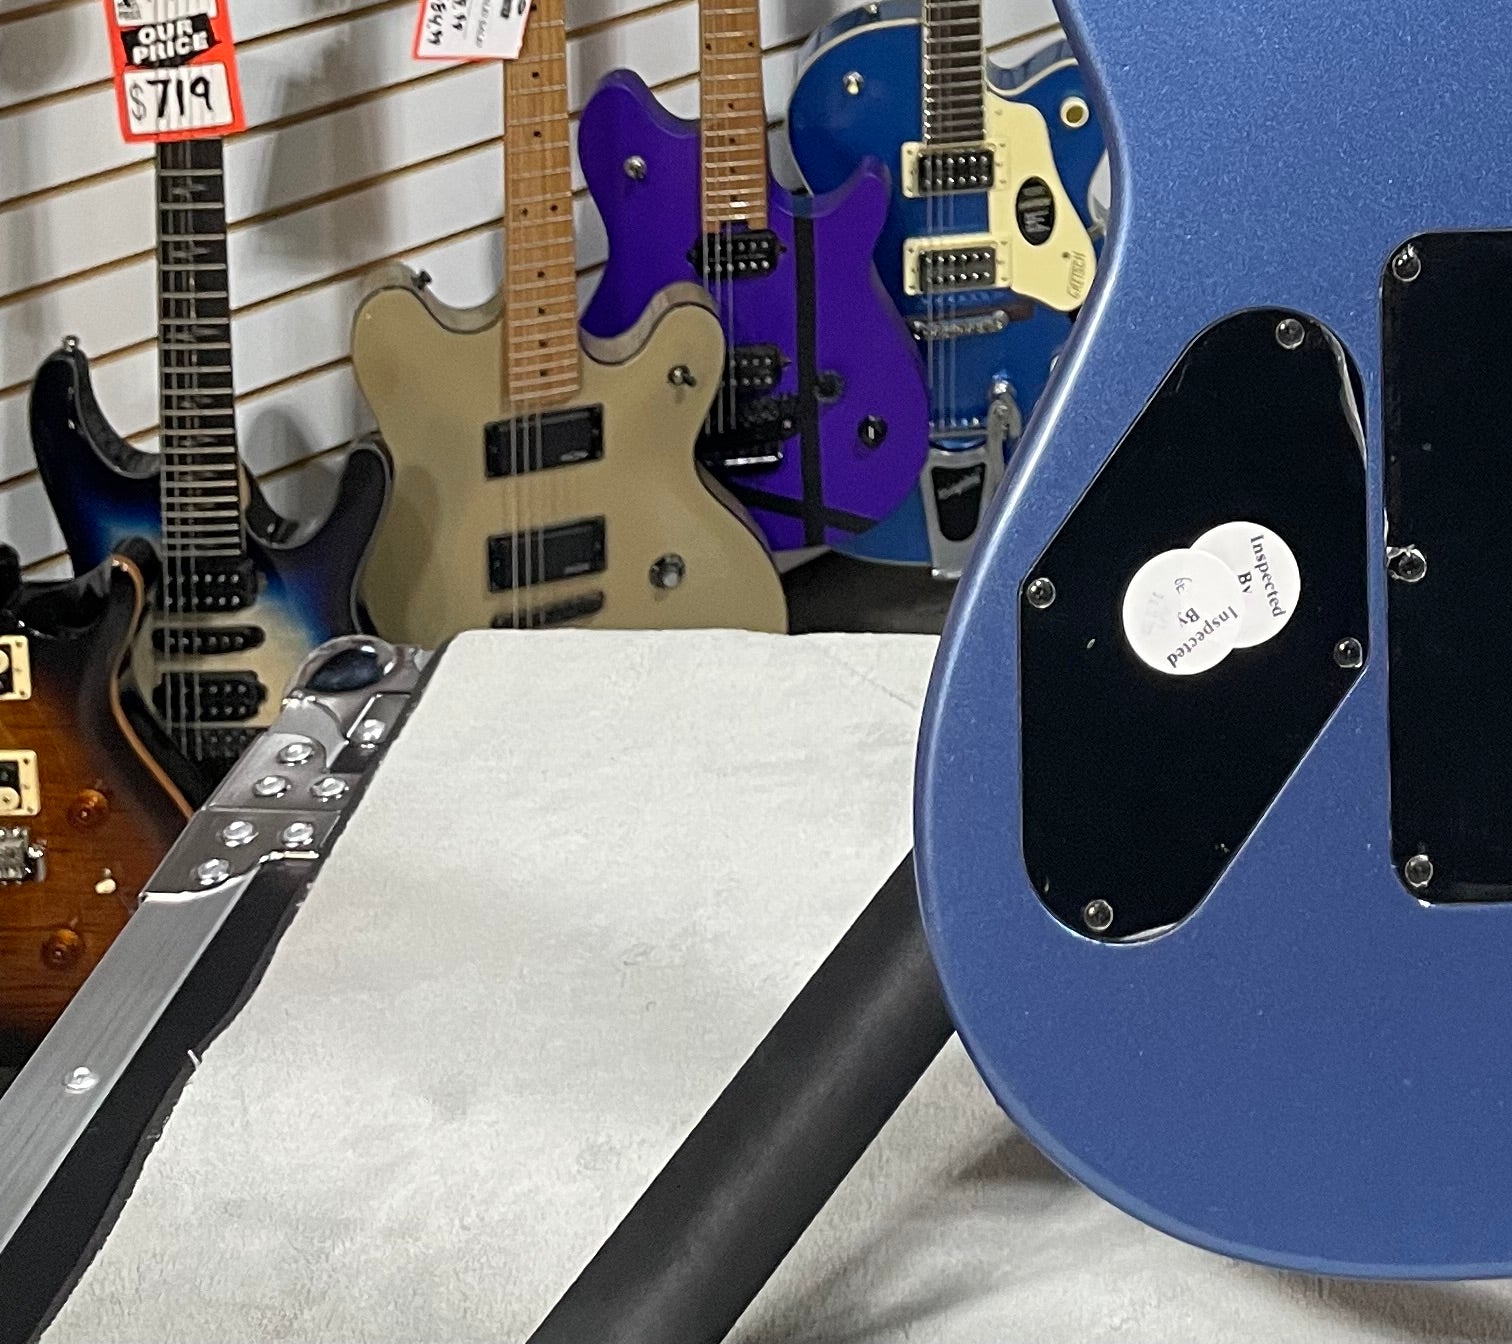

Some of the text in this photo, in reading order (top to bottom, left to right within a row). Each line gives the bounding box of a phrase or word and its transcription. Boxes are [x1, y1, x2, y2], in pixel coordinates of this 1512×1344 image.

[131, 30, 210, 66] PRICE
[137, 19, 194, 46] OUR
[128, 75, 214, 122] $719
[1250, 533, 1288, 619] Inspected
[1166, 604, 1240, 670] Inspected
[1176, 606, 1202, 630] By
